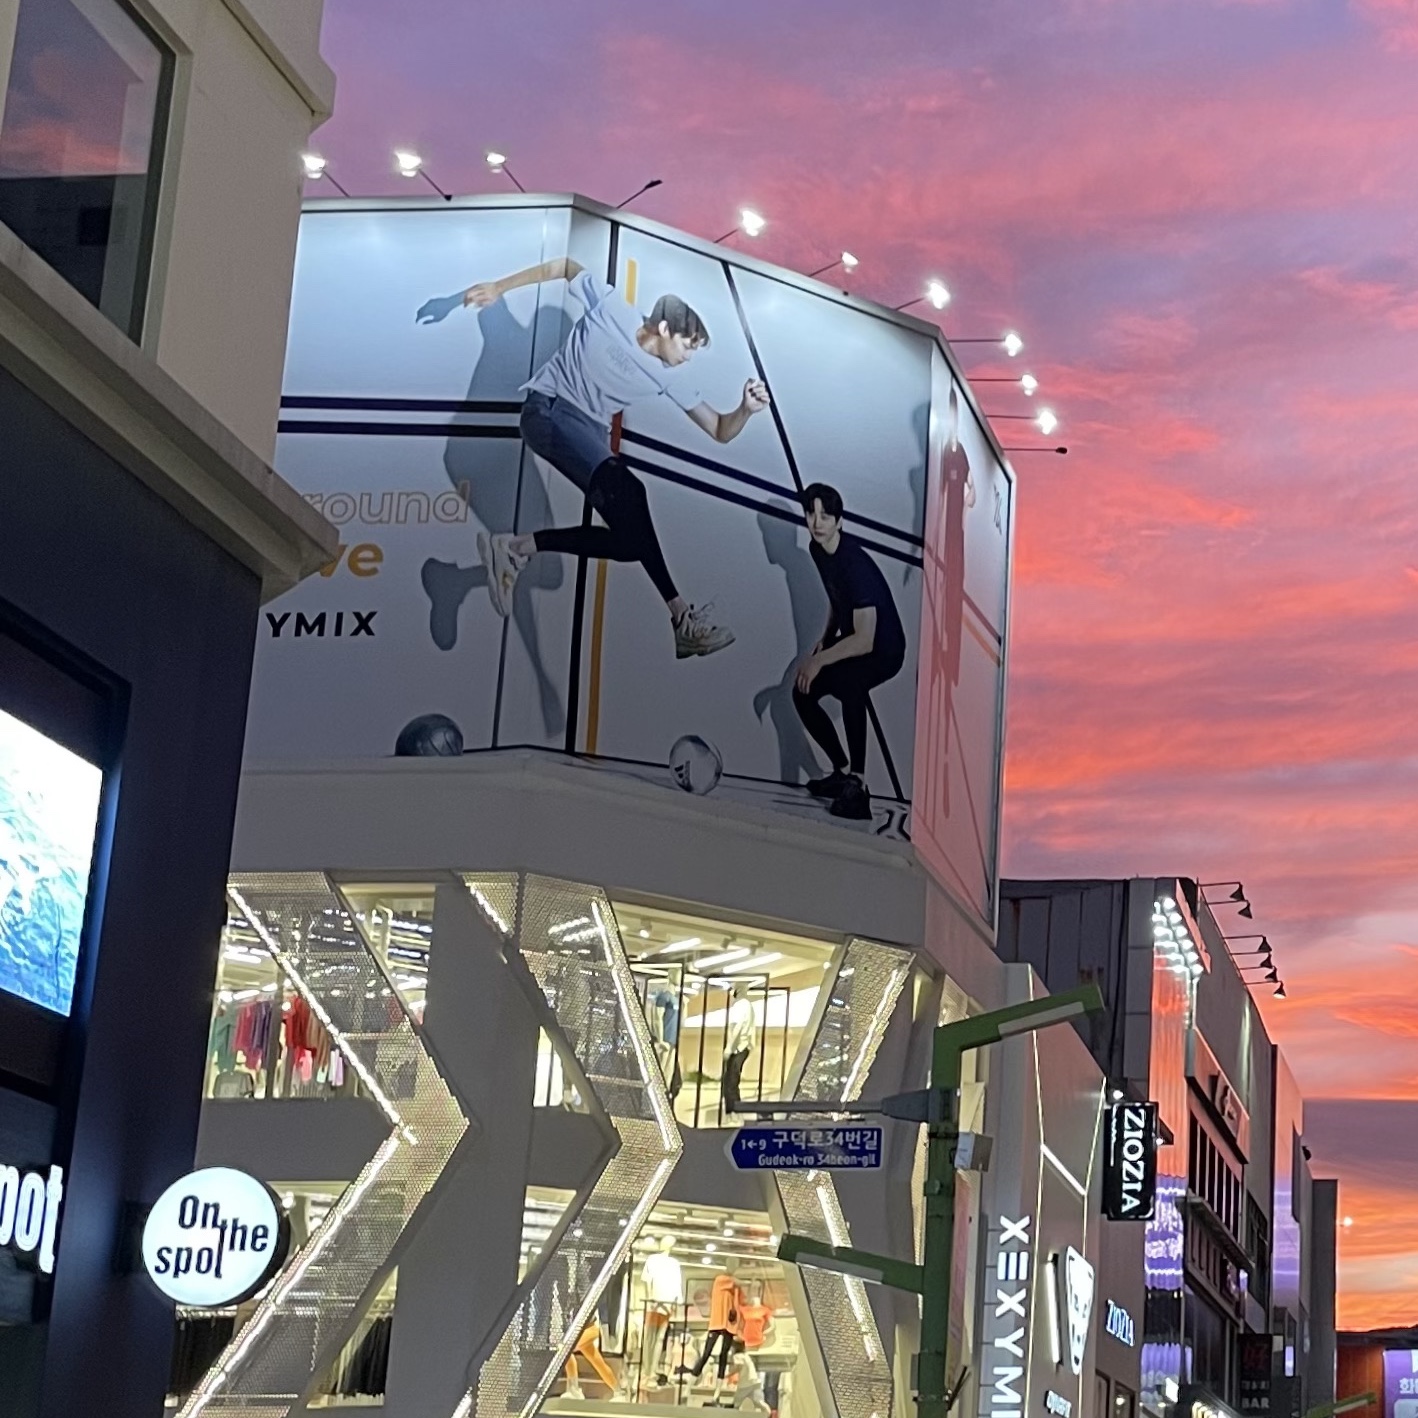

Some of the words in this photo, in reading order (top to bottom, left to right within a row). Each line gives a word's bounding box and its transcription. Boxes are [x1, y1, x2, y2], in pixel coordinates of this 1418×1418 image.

[266, 611, 378, 638] YMIX
[758, 1154, 815, 1166] Gudeok-ro
[1121, 1108, 1146, 1213] ZIOZIA
[178, 1195, 220, 1229] On
[216, 1218, 269, 1252] the
